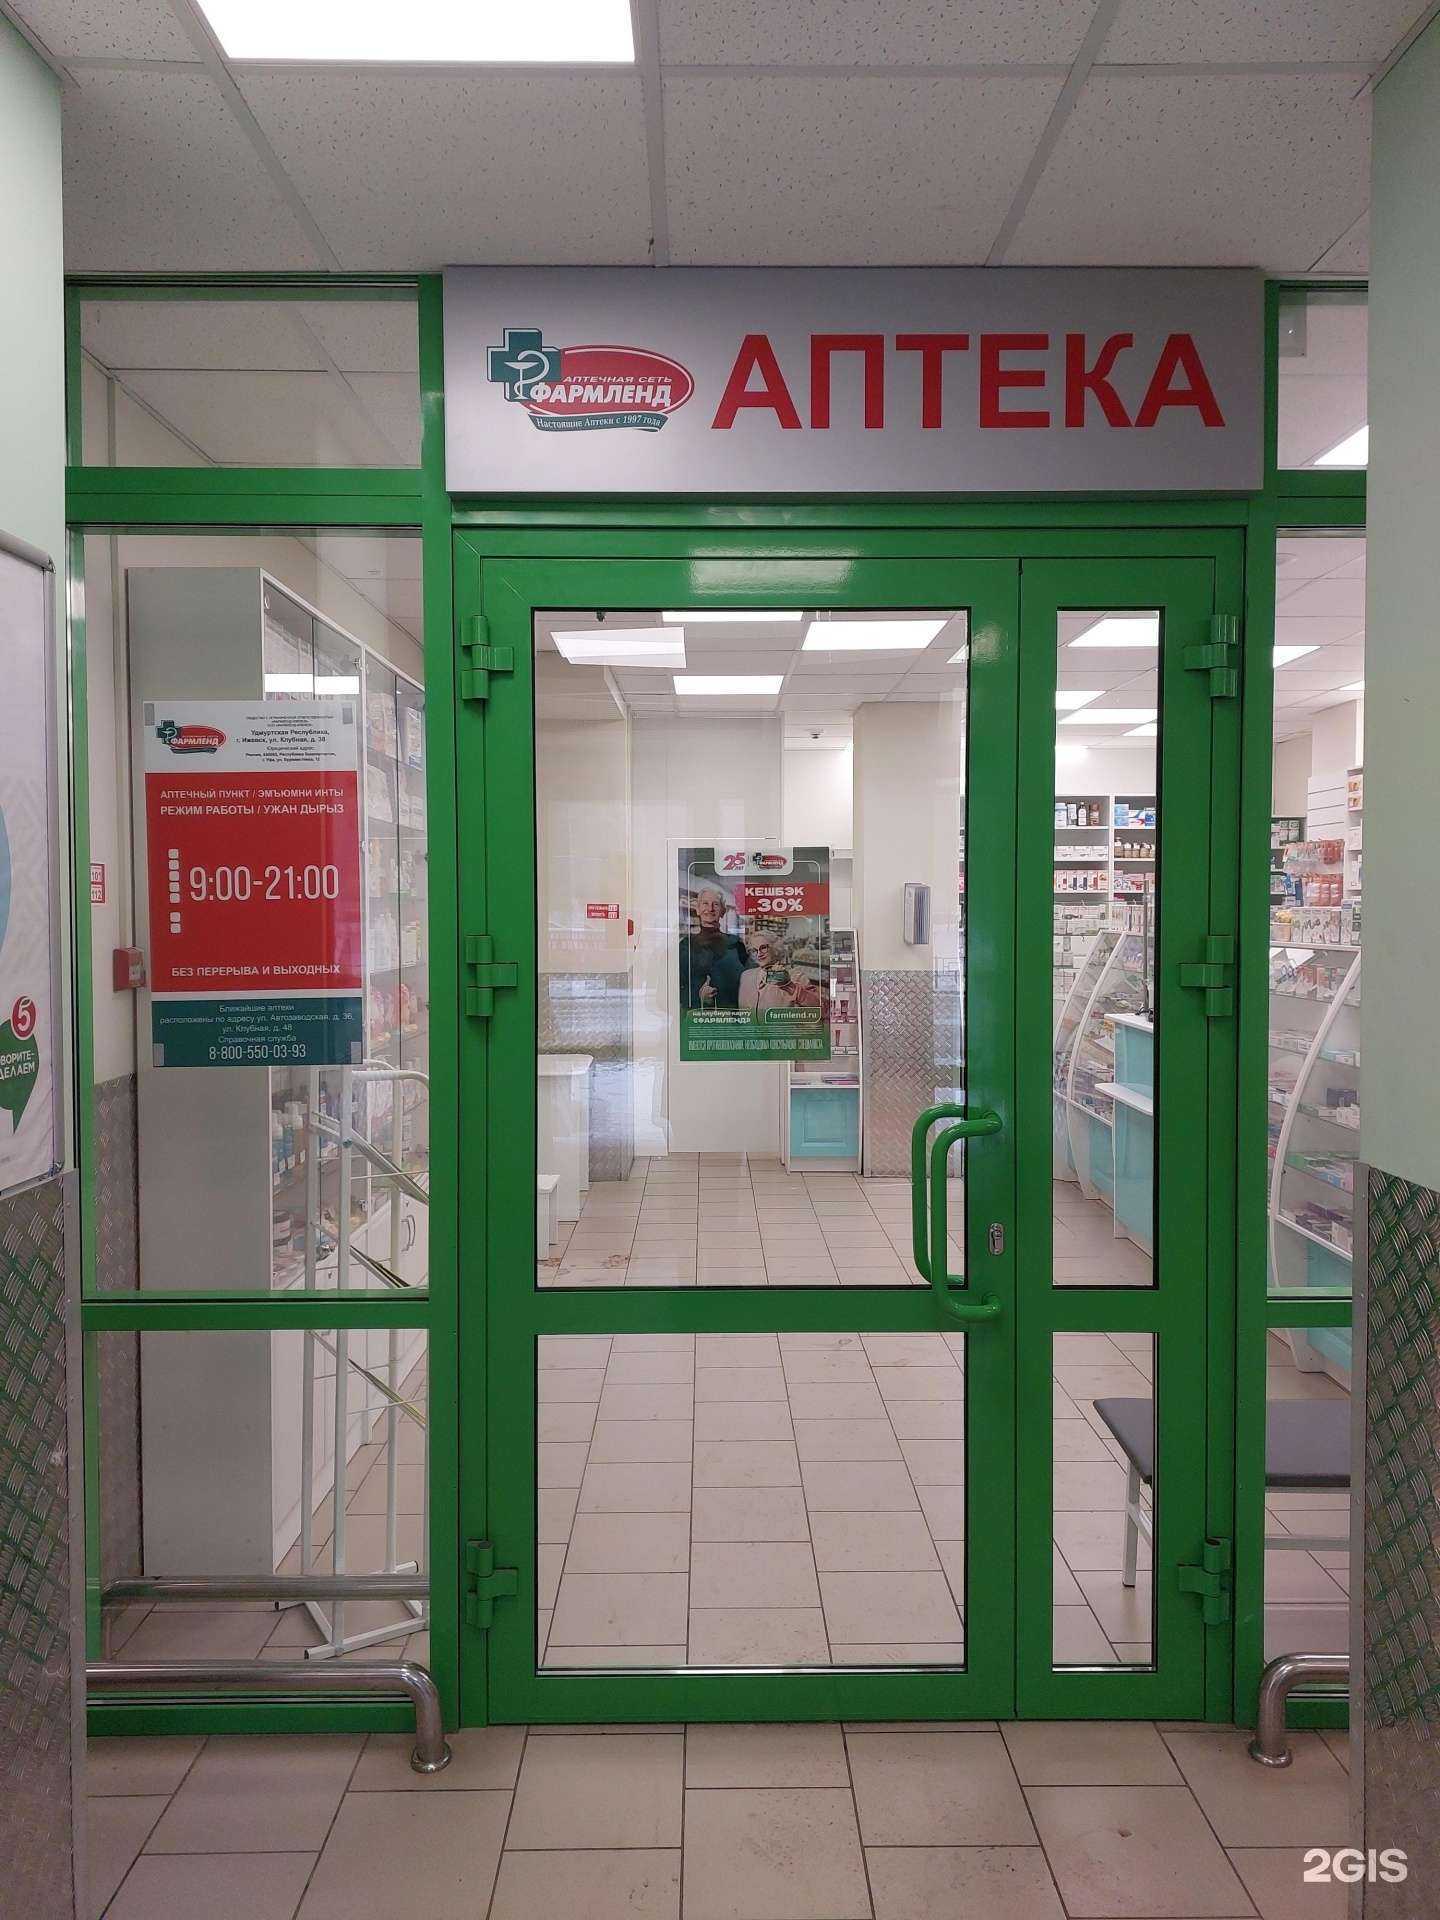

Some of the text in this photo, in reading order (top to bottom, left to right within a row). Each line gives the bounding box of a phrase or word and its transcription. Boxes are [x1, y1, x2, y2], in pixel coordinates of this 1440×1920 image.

[562, 375, 673, 383] АПТЕЧНАЯ СЕТЬ
[711, 333, 1226, 429] АПТЕКА
[529, 384, 671, 407] ФАРМЛЕНД
[536, 417, 583, 429] Настоящие
[585, 416, 614, 427] Аптеки
[622, 414, 642, 425] 1997
[251, 728, 330, 737] Удмуртская Республика,
[171, 737, 219, 746] ФАРМЛЕНД
[160, 788, 217, 799] АПТЕЧНЫЙ
[219, 788, 250, 798] ПУНКТ
[258, 788, 313, 798] ЭМЪЮМНИ
[314, 788, 344, 797] ИНТЫ
[160, 805, 204, 815] РЕЖИМ
[206, 805, 254, 815] РАБОТЫ
[263, 804, 298, 815] УЖАН
[299, 803, 345, 814] ДЫРЫЗ
[189, 864, 340, 901] 9:00-21:00
[745, 886, 805, 896] КЕШБЭК
[757, 898, 804, 912] 30%
[171, 964, 341, 977] БЕЗ ПЕРЕРЫВА И ВЫХОДНЫХ
[219, 1004, 265, 1012] Ближайшие
[160, 1017, 214, 1025] расположены
[228, 1016, 255, 1024] адресу
[770, 1011, 818, 1019] farmlend.ru
[222, 1026, 233, 1034] ул.
[218, 1034, 297, 1044] Справочная служба
[0, 1049, 35, 1066] ВОРИТЕ-
[209, 1043, 307, 1061] 8-800-550-03-93
